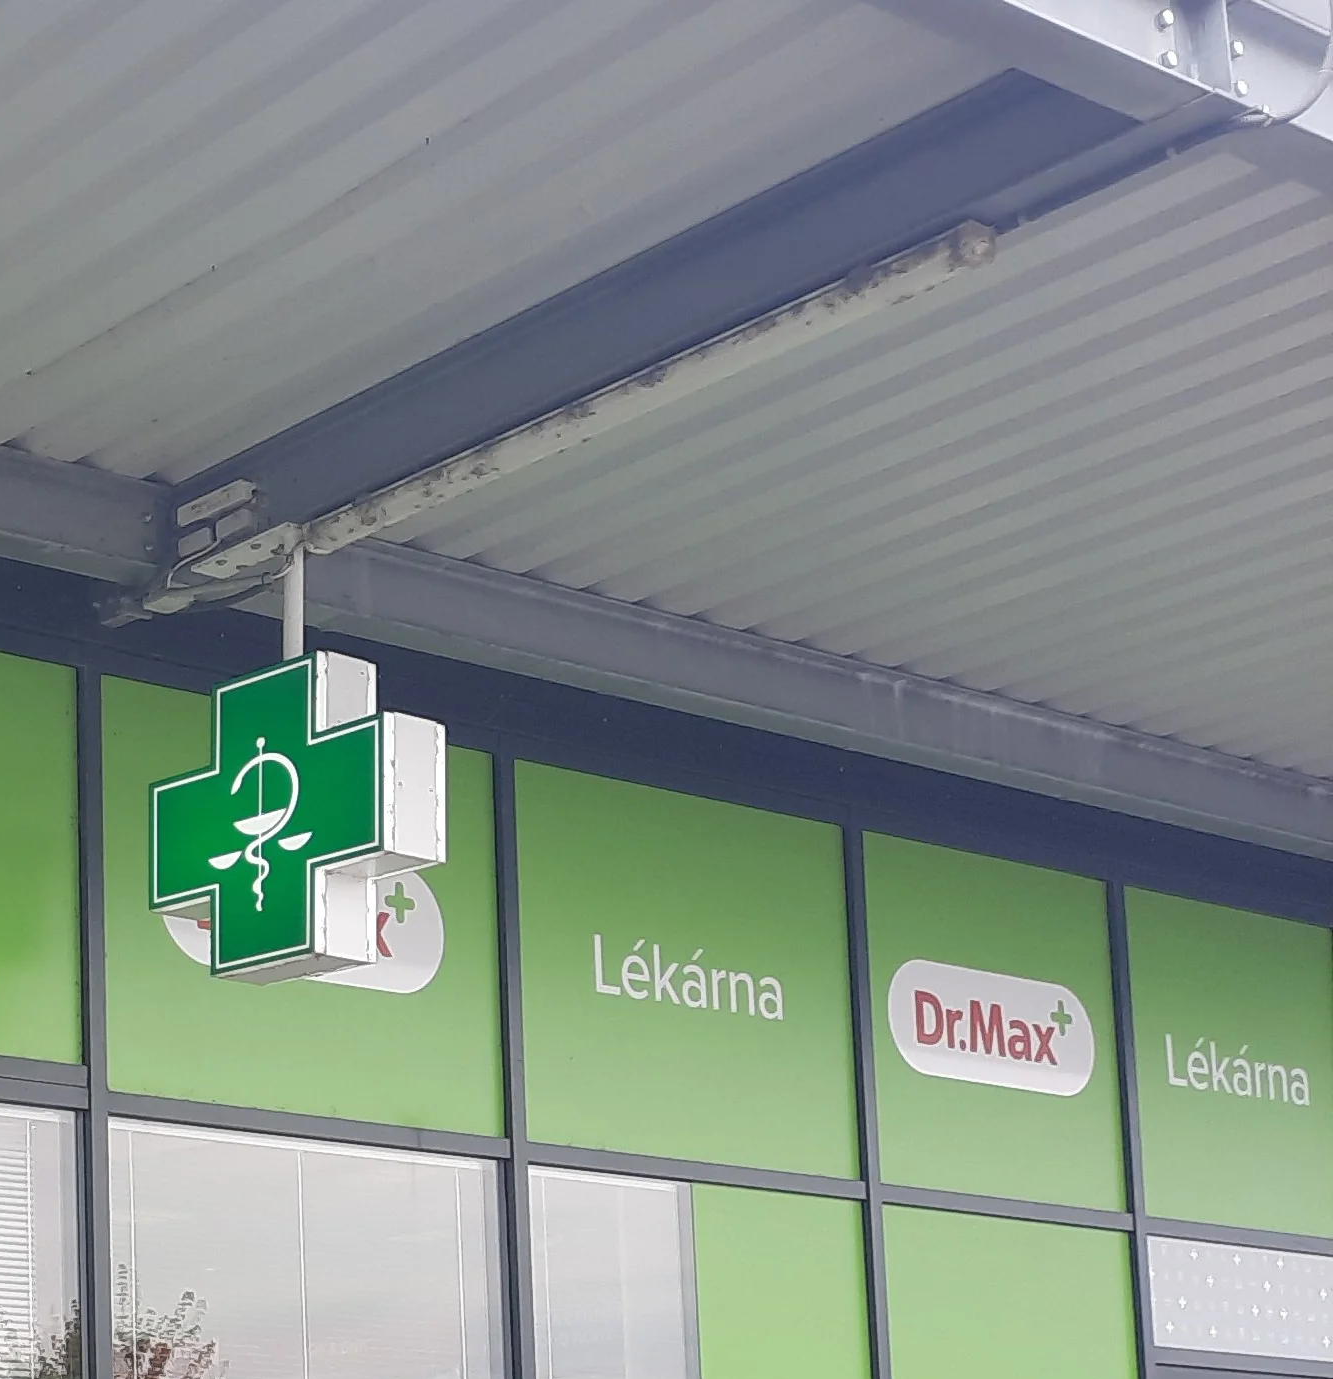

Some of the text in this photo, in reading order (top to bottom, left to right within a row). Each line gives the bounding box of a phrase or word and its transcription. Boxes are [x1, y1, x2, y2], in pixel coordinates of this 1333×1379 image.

[592, 932, 785, 1021] Lékárna
[913, 989, 1059, 1067] Dr.Max
[1164, 1032, 1312, 1107] Lékárna
